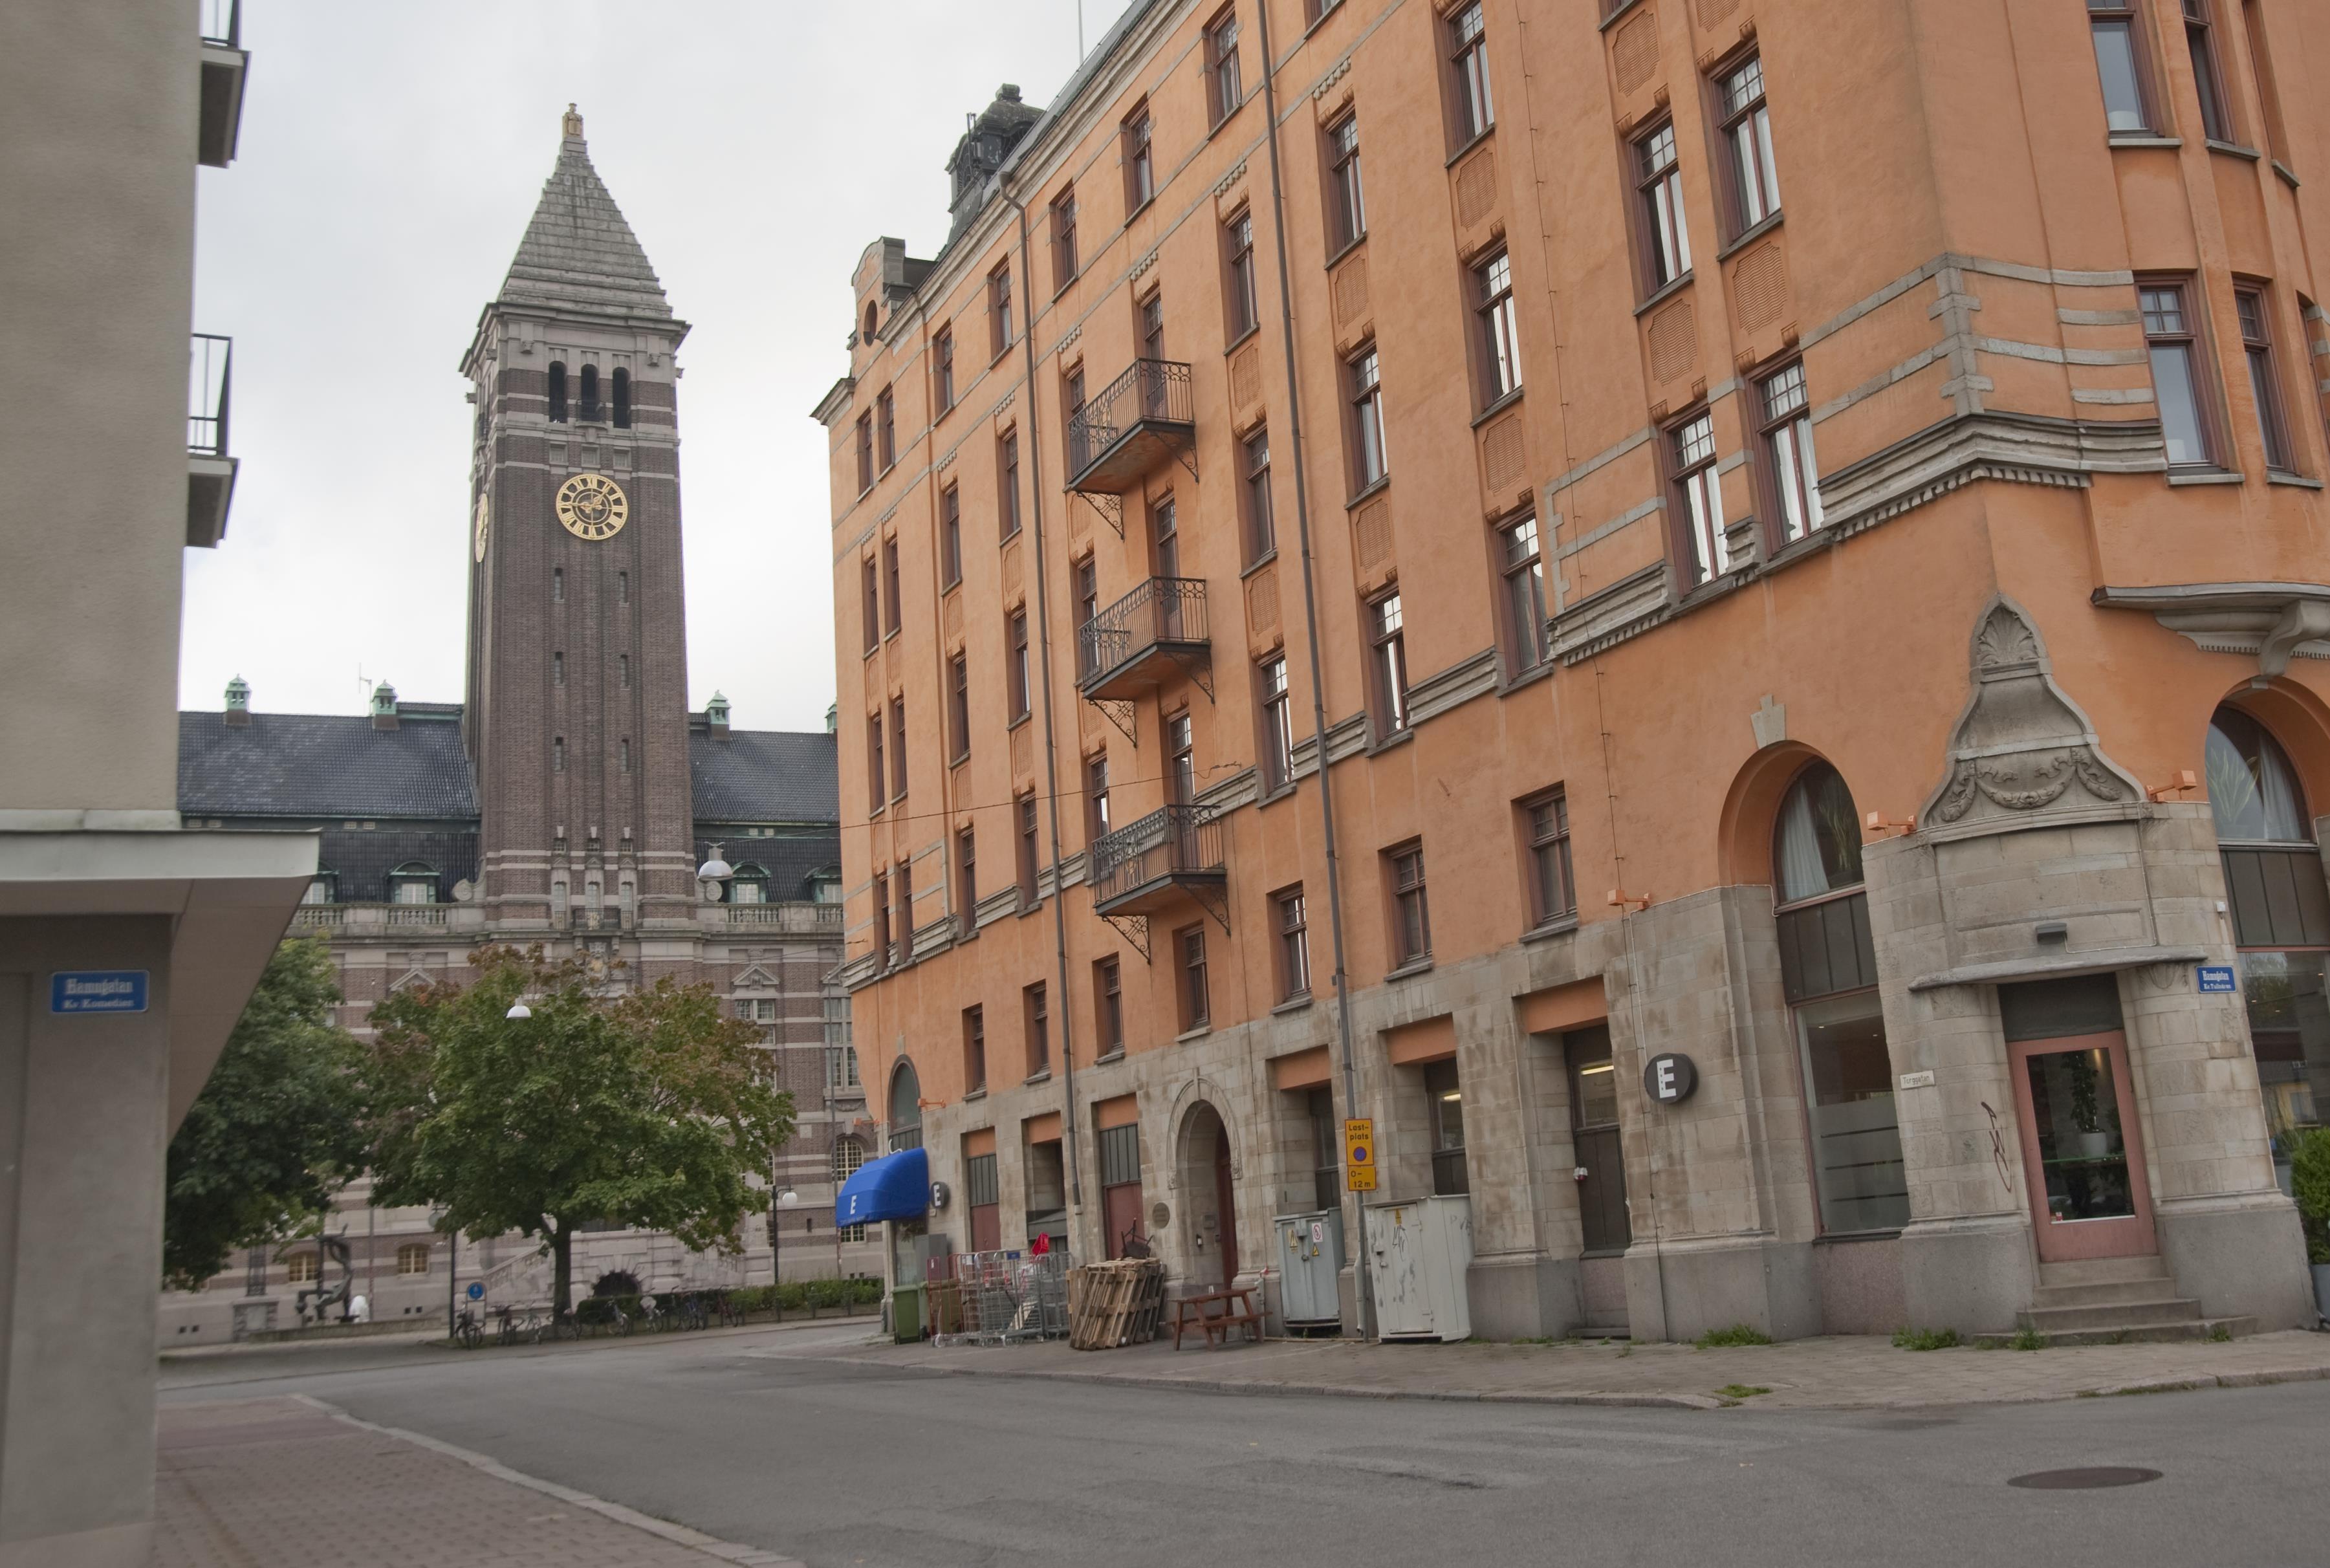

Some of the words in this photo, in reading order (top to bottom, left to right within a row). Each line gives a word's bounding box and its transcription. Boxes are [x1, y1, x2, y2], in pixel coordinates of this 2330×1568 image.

[1657, 1059, 1677, 1098] E
[850, 1195, 857, 1215] E
[933, 1184, 941, 1206] E
